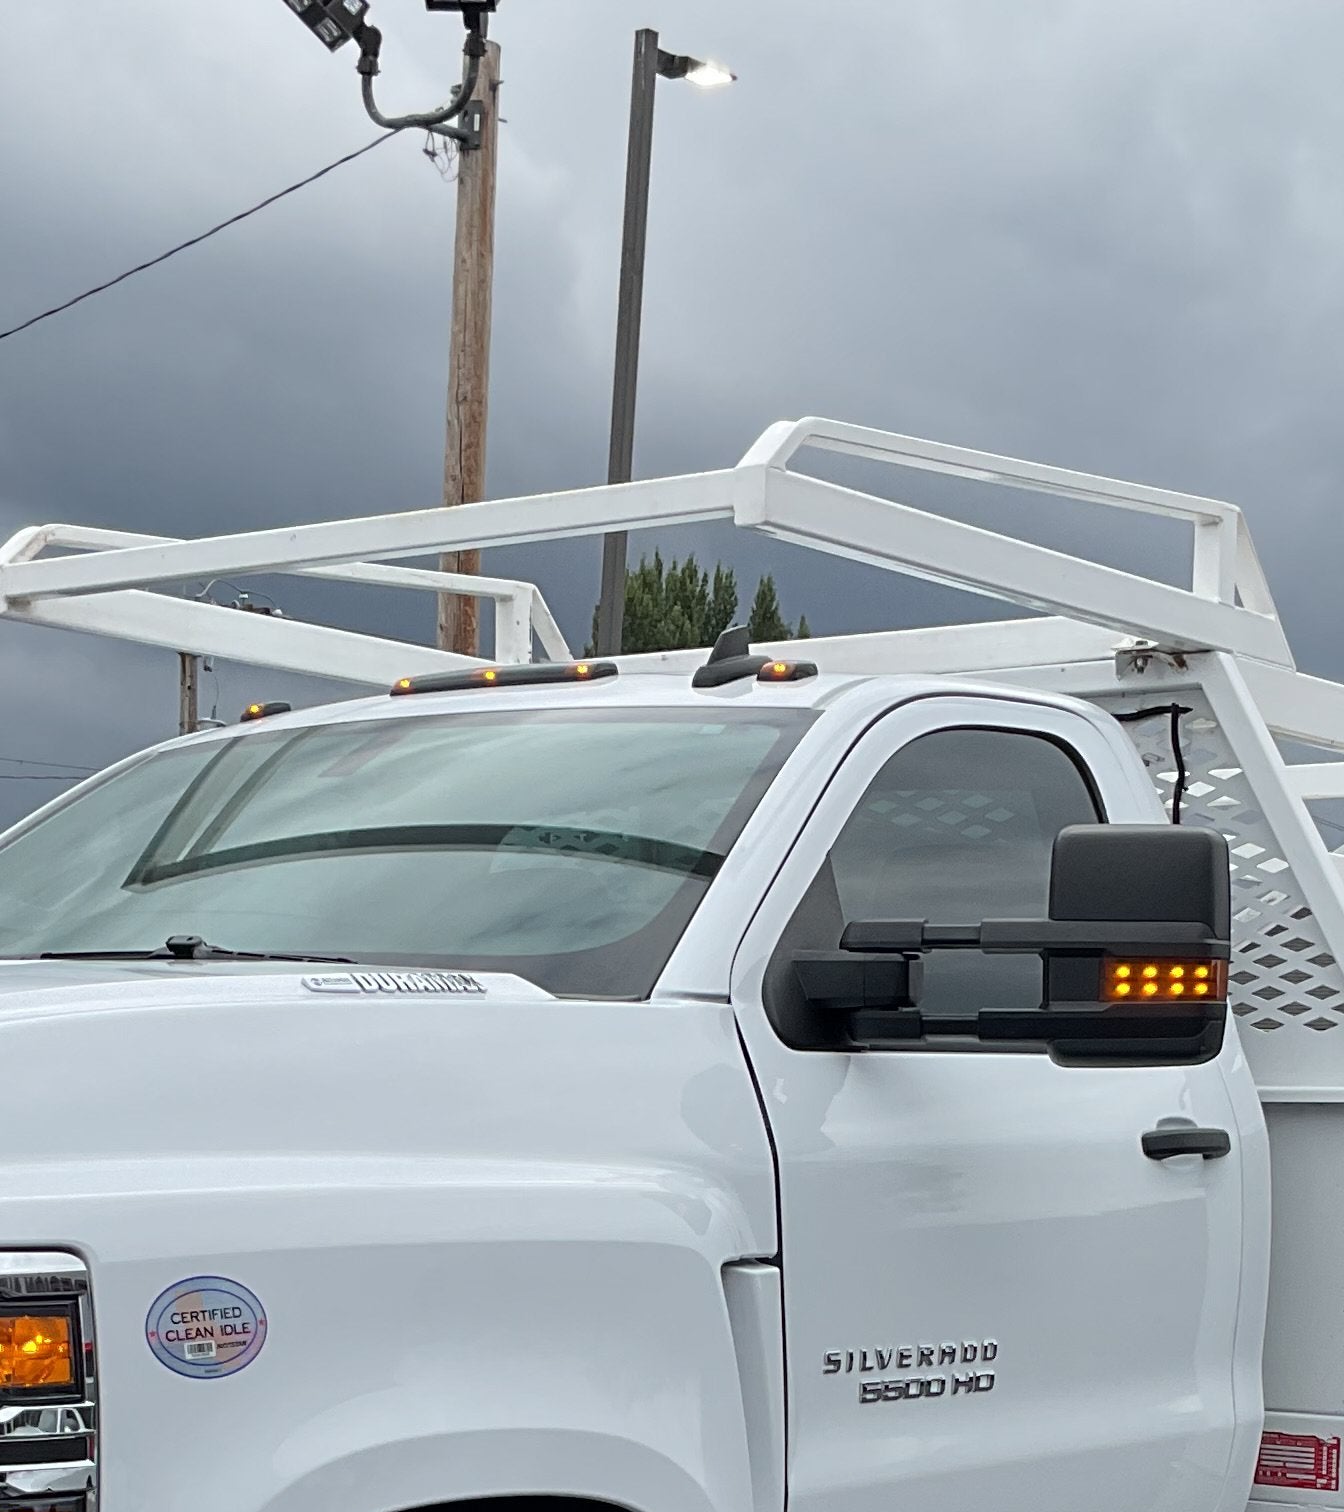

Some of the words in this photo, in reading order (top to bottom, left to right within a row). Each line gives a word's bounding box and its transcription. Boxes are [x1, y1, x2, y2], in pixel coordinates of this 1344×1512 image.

[350, 973, 487, 993] DURAMAX
[170, 1306, 242, 1325] CERTIFIED
[165, 1326, 214, 1342] CLEAN
[219, 1322, 251, 1336] IDLE
[823, 1338, 998, 1374] SILVERADO
[859, 1375, 946, 1403] 5500
[951, 1370, 996, 1395] HD
